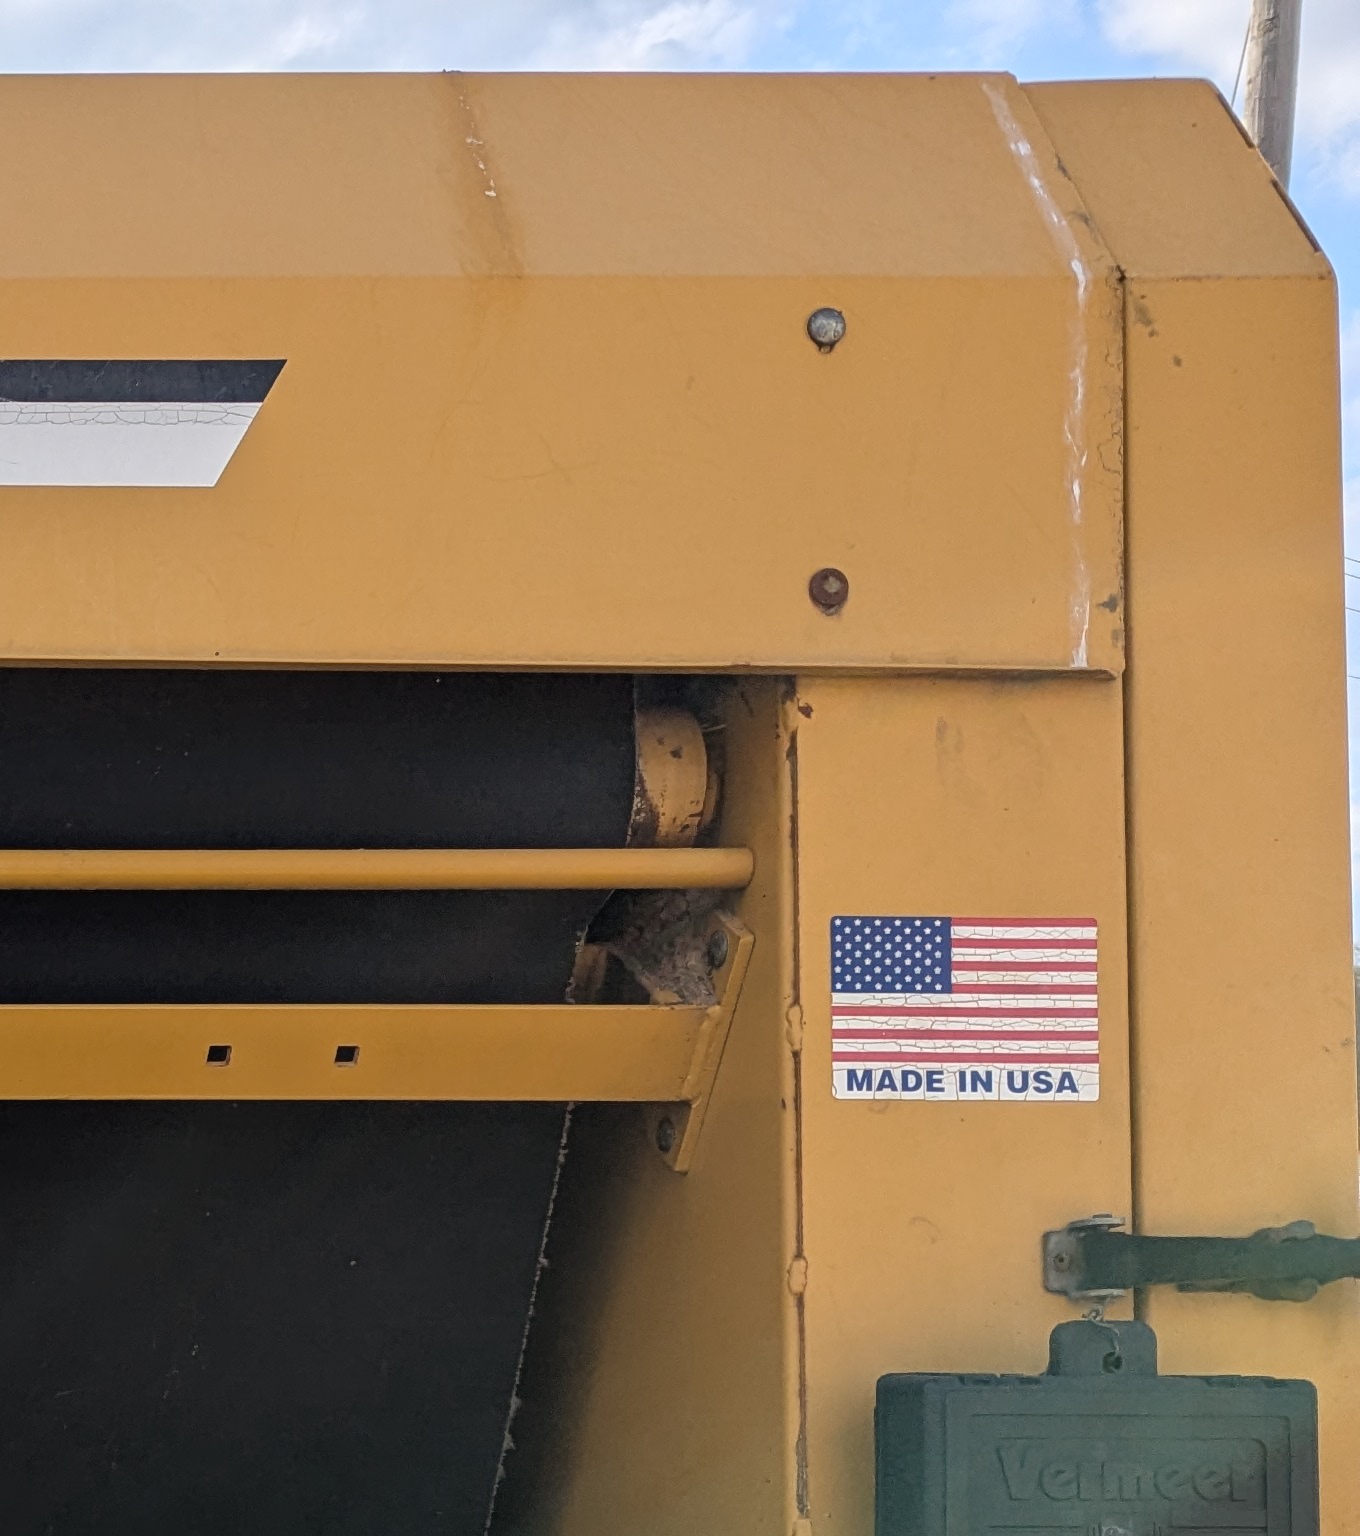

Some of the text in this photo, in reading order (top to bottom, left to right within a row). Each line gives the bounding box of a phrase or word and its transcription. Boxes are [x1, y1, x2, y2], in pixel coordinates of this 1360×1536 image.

[846, 1069, 1079, 1094] MADE IN USA
[995, 1446, 1251, 1501] Vermeer
